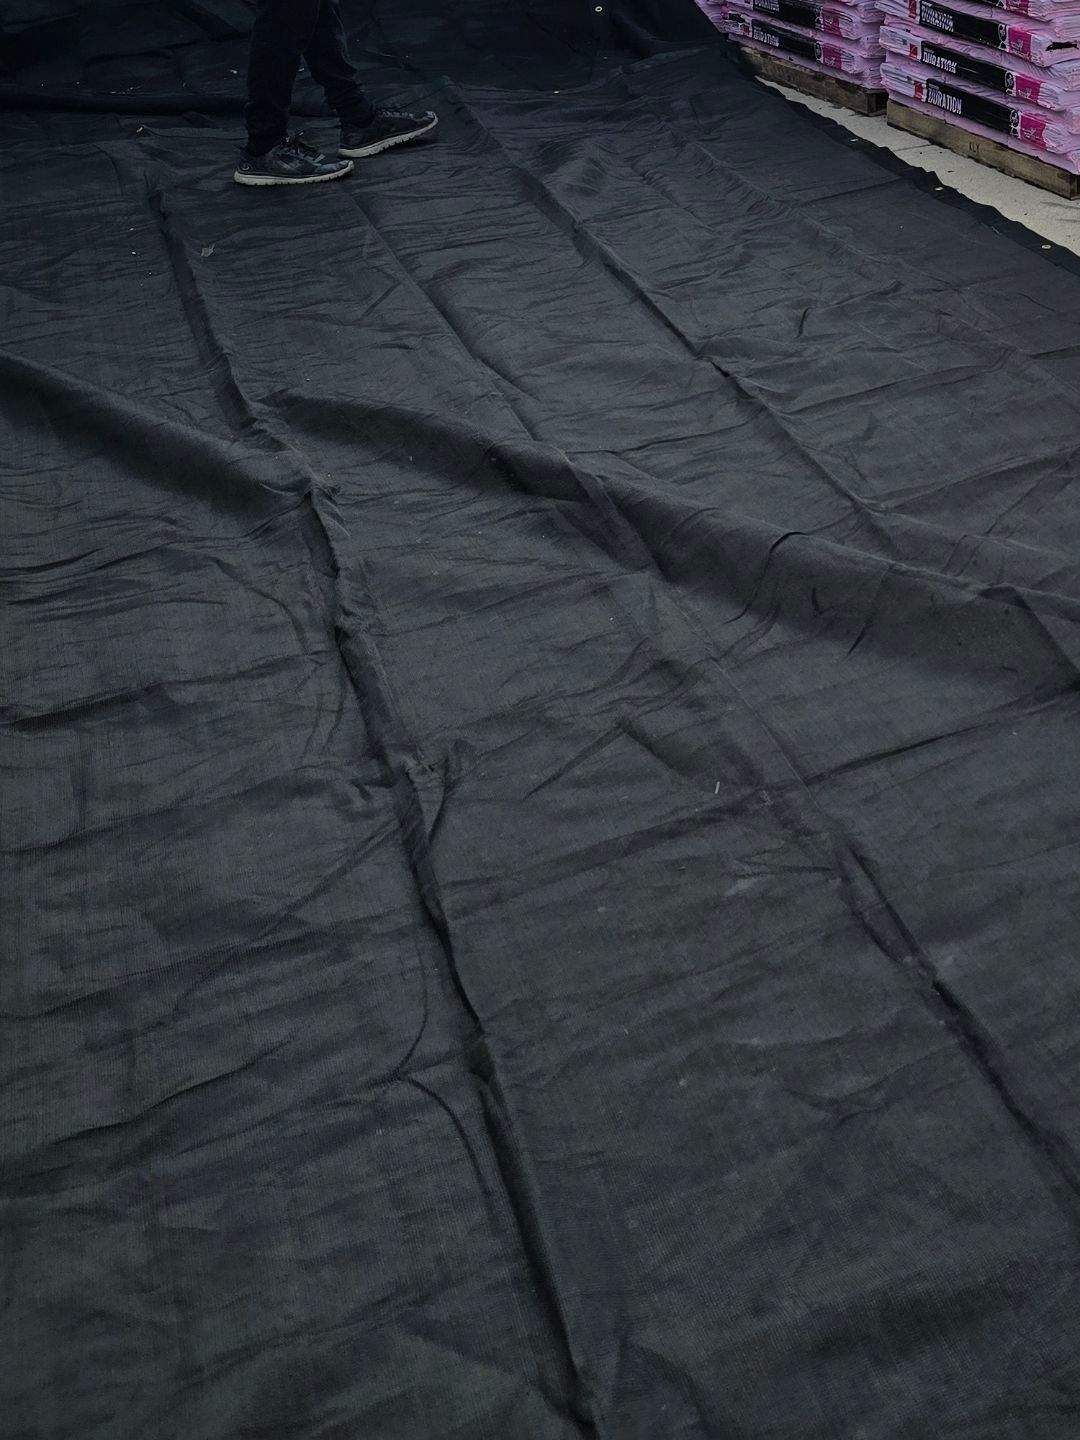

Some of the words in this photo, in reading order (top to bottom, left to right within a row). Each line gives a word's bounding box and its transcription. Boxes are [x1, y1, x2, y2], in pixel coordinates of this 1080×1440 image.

[921, 5, 955, 32] DURATION
[923, 50, 957, 73] DURATION
[928, 89, 962, 115] DURATION
